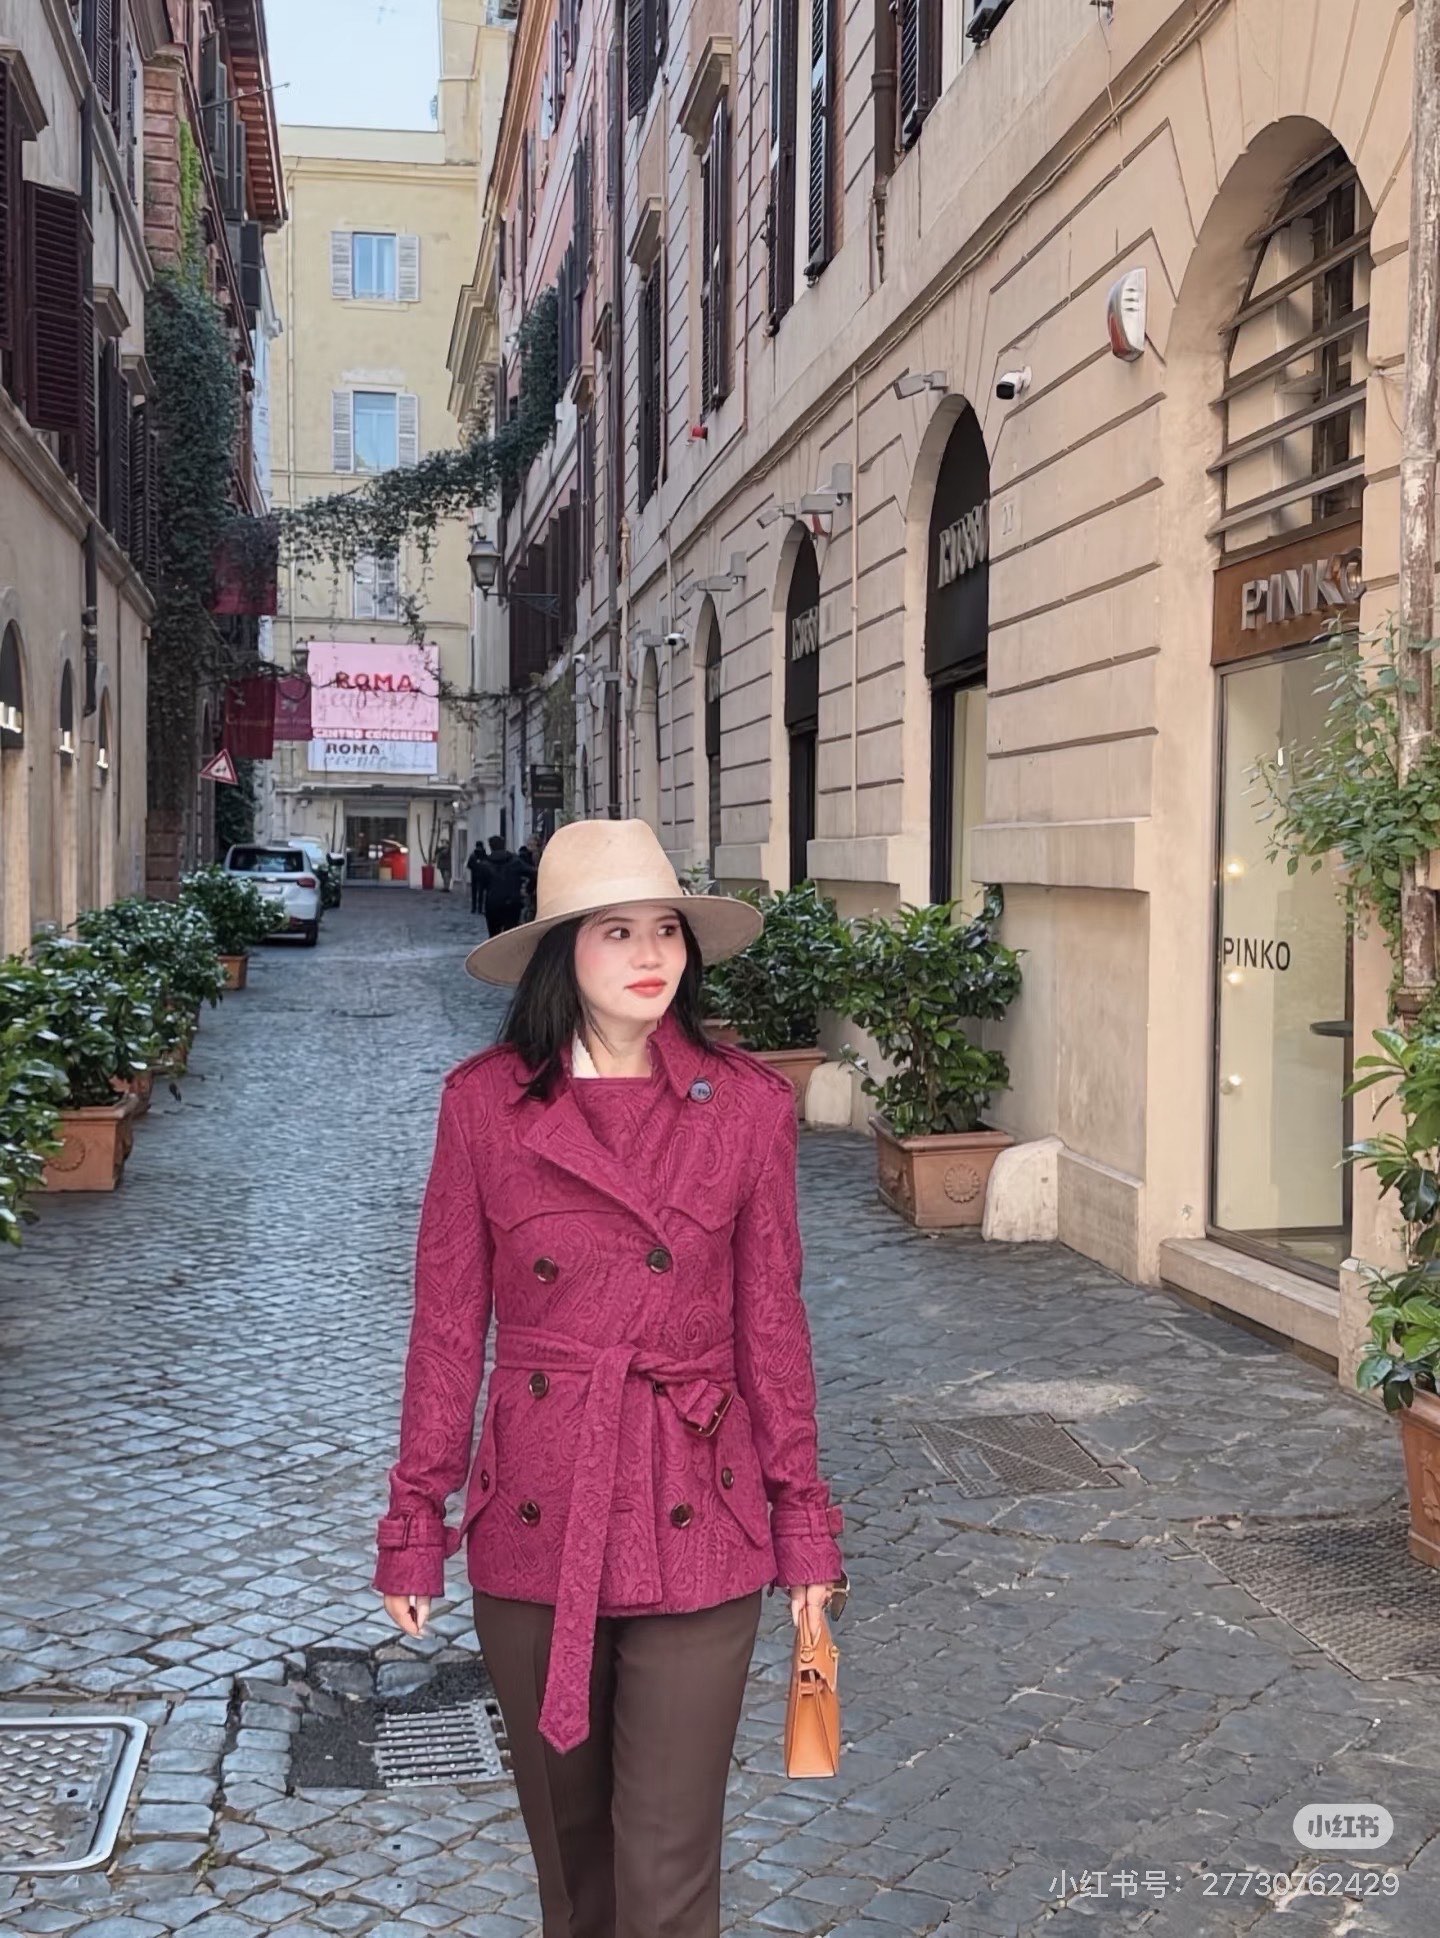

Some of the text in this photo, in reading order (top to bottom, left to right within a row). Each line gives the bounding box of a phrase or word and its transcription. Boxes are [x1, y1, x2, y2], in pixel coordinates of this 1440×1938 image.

[1241, 549, 1366, 631] PINKO
[335, 671, 413, 692] ROMA
[325, 742, 381, 755] ROMA
[1223, 937, 1291, 971] PINKO
